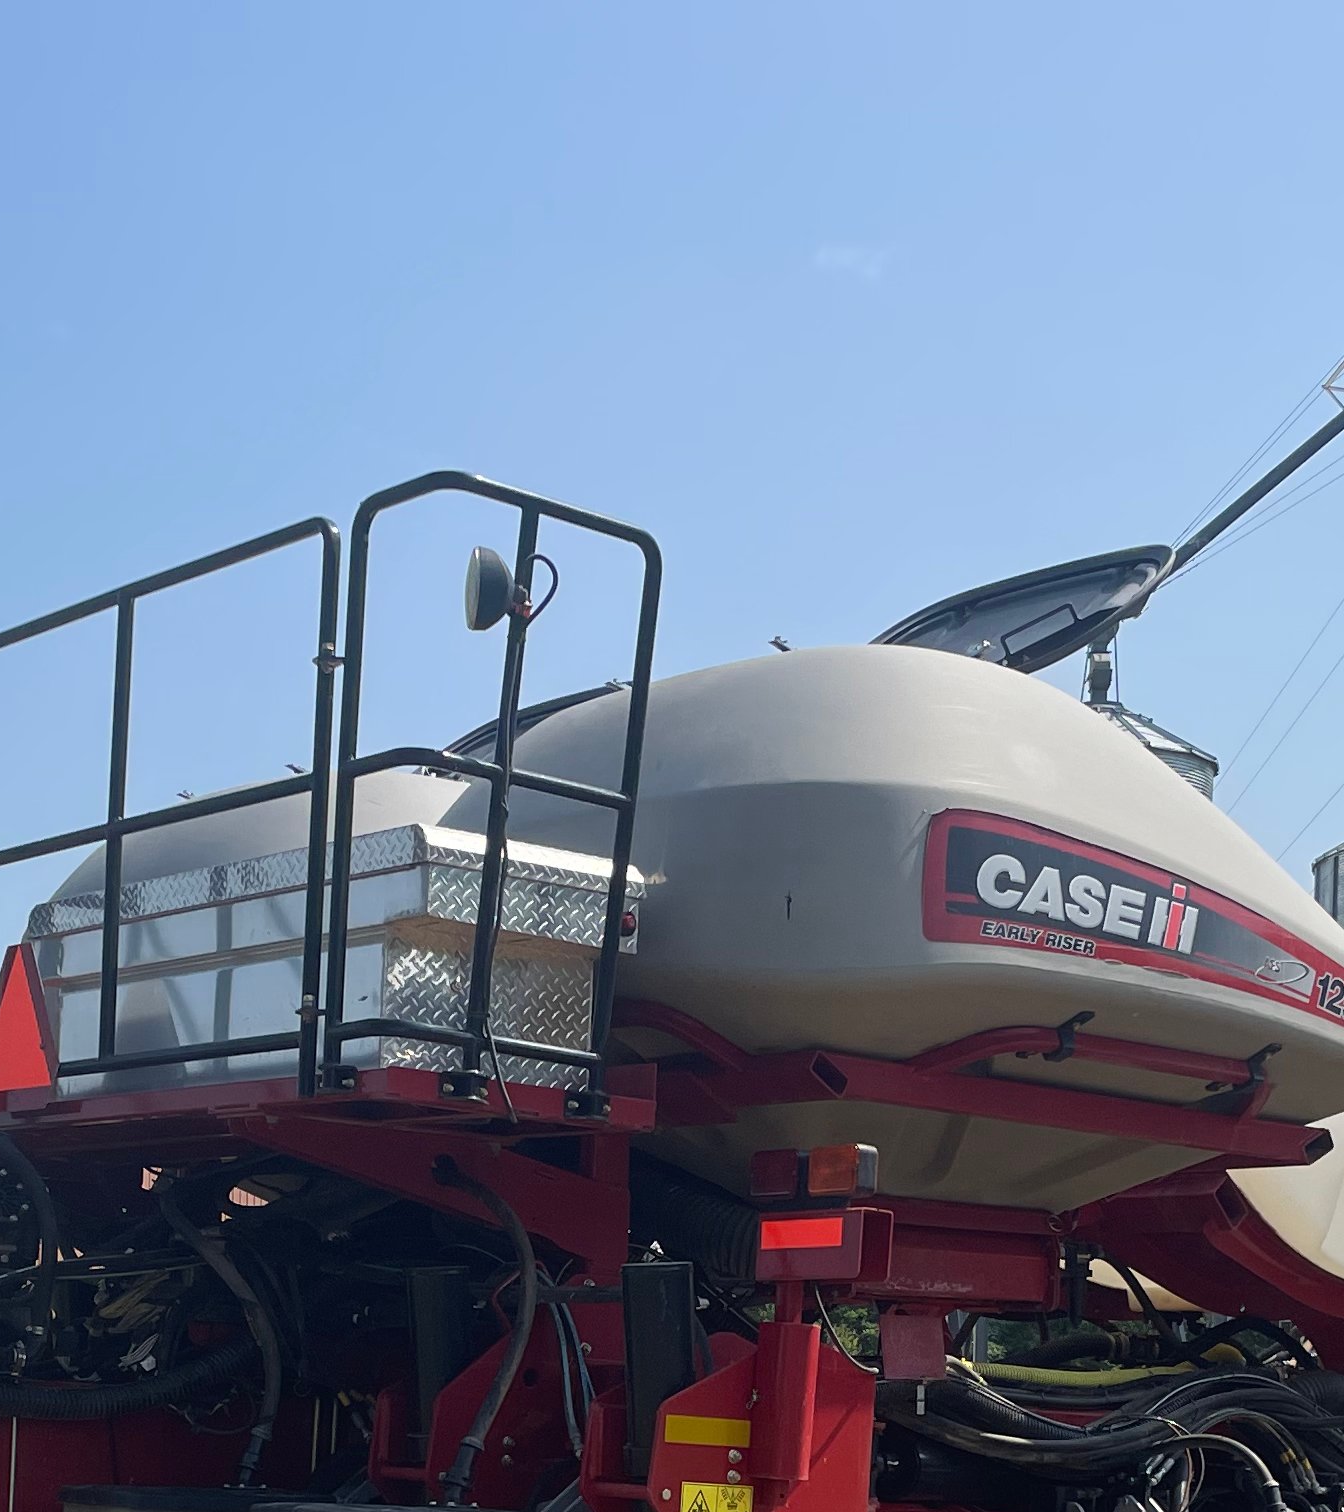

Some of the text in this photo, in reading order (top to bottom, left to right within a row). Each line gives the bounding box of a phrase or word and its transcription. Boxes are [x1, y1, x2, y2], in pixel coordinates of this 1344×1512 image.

[976, 853, 1199, 955] CASE IH
[980, 919, 1096, 957] EARLY RISER
